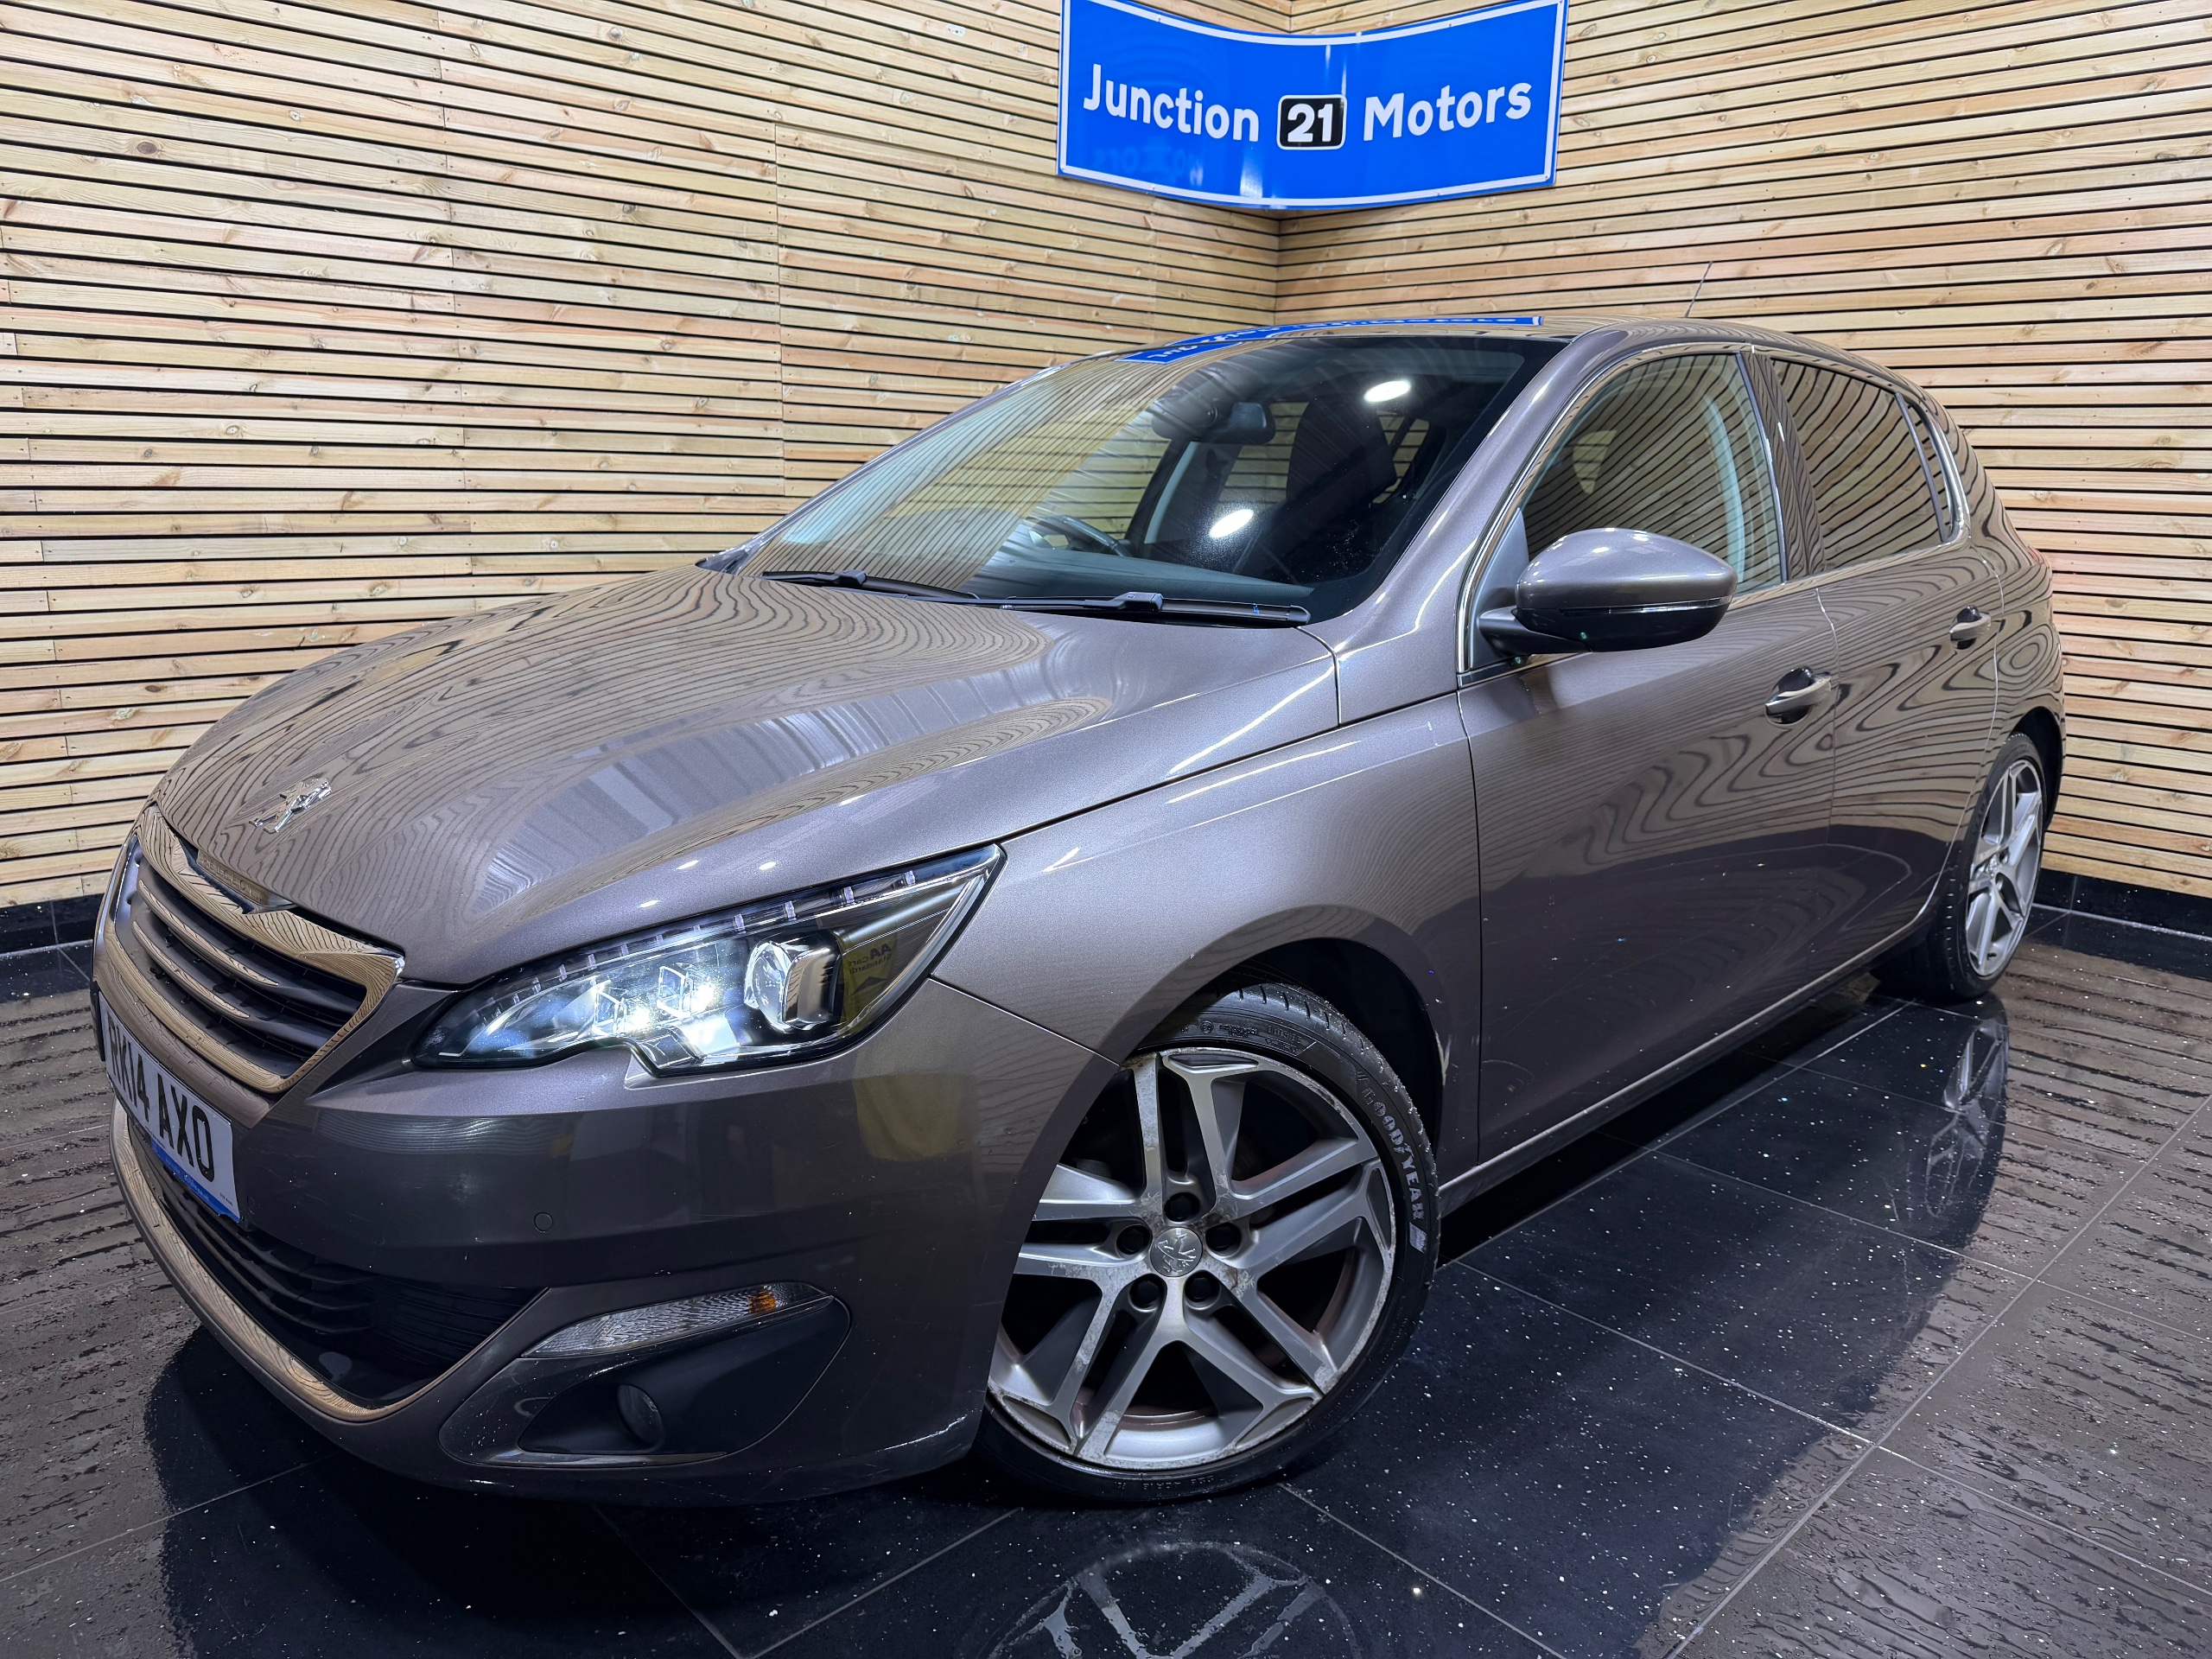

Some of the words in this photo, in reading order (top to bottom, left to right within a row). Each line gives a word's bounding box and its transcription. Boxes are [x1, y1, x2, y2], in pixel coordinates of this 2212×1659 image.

[1083, 64, 1260, 142] Junction
[1287, 103, 1334, 143] 21
[1363, 82, 1532, 142] Motors
[107, 1011, 150, 1122] RK14
[157, 1073, 215, 1183] AXO
[1361, 1087, 1425, 1220] GOODYEAR
